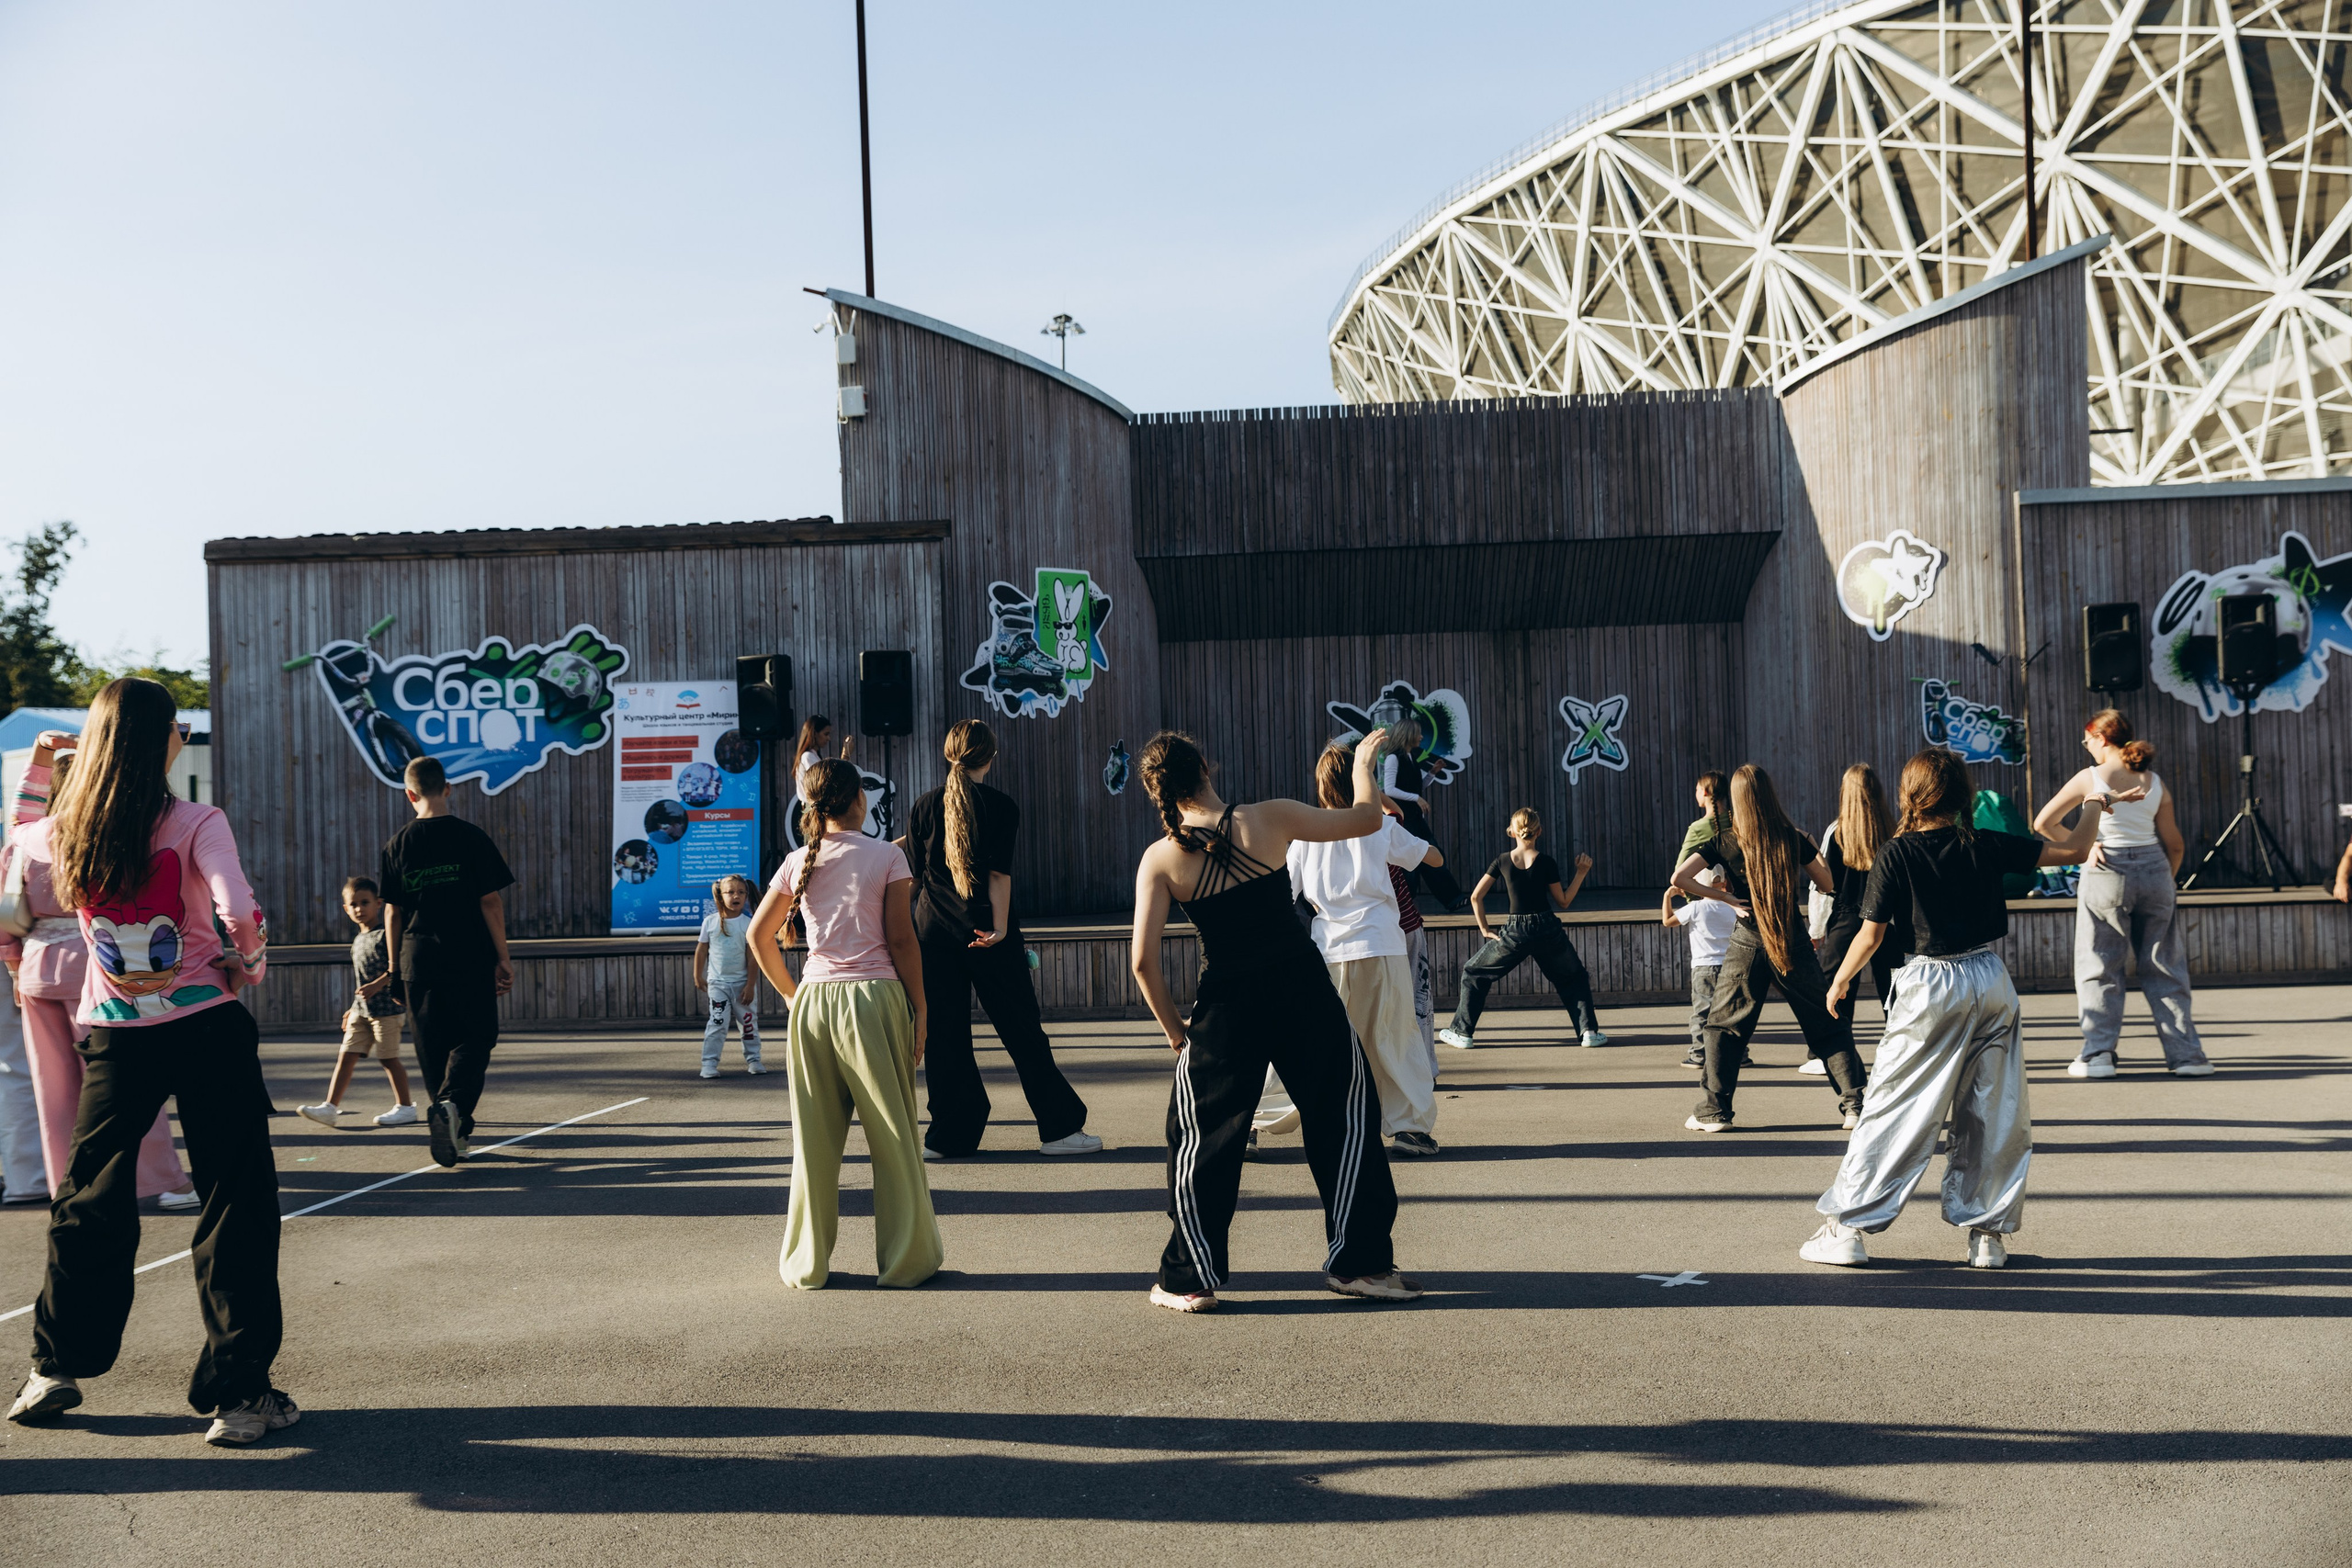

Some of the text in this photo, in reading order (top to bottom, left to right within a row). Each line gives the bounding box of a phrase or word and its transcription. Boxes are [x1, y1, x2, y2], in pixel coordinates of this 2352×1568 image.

[392, 662, 540, 712] Сбер
[624, 712, 740, 723] Культурный центр «Мирин
[1944, 700, 2007, 741] Сбер
